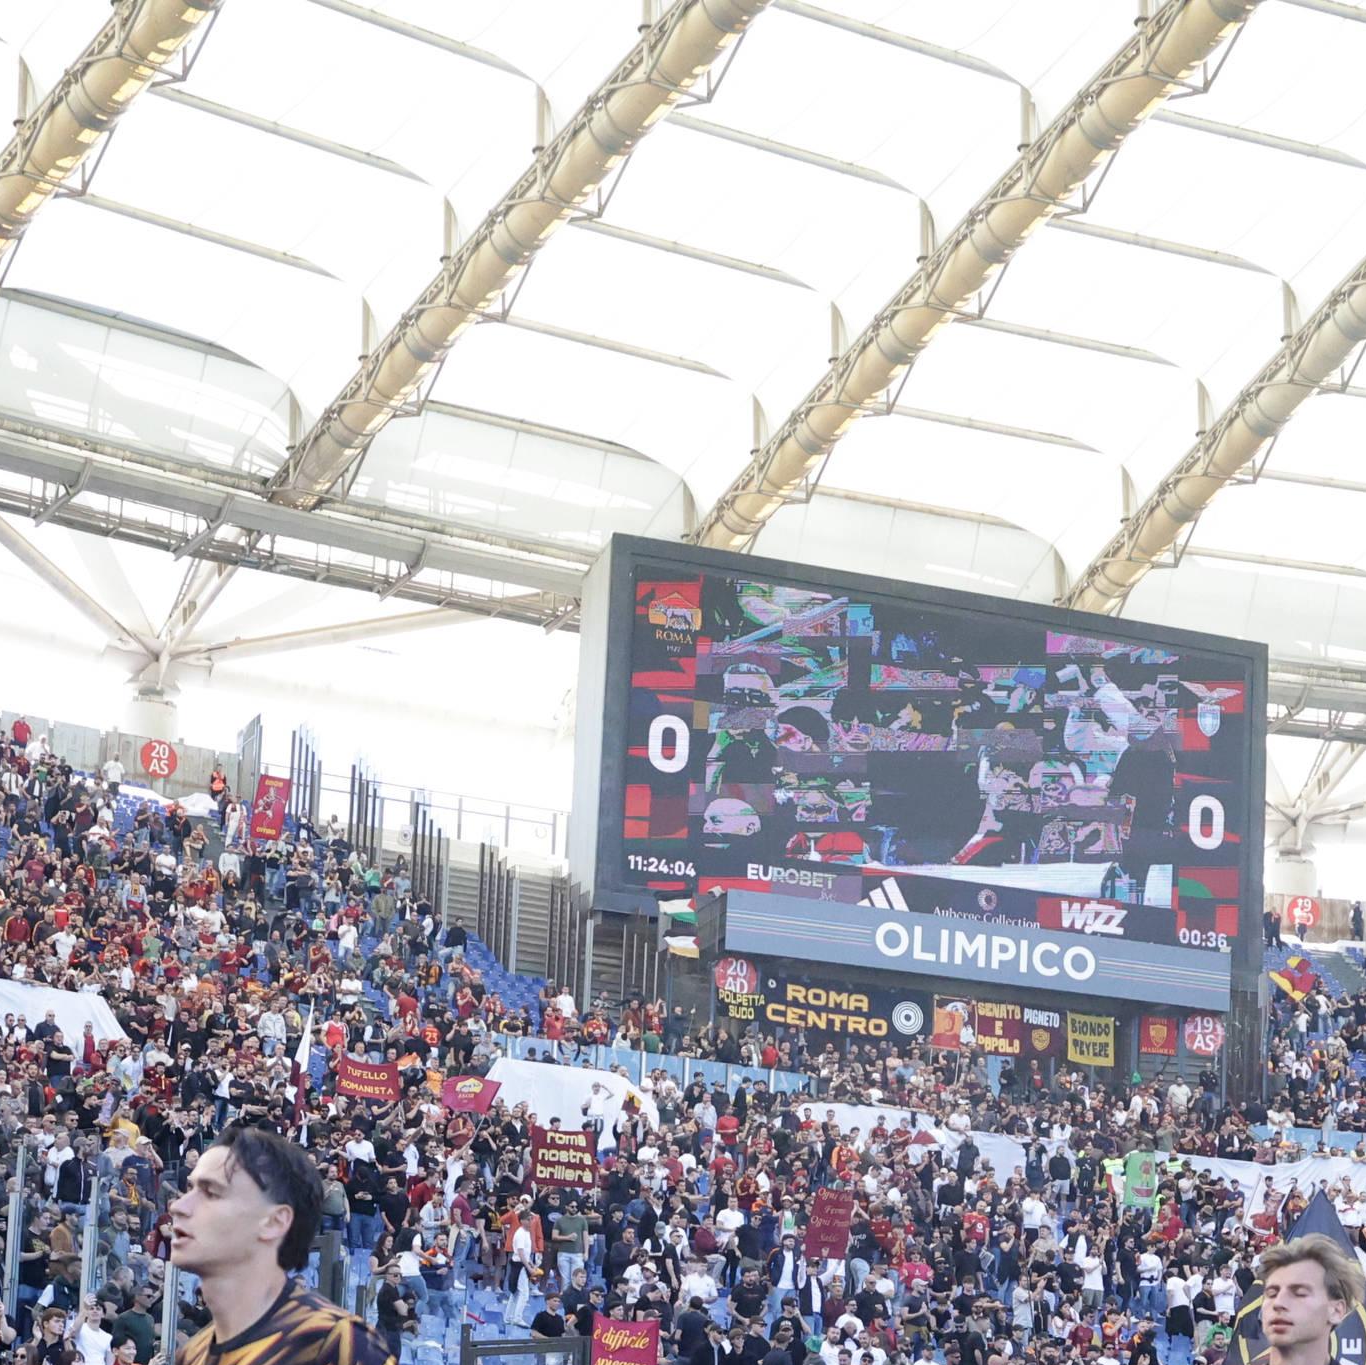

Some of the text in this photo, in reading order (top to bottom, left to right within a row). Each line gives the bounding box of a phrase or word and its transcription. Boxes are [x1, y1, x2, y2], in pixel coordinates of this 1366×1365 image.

[655, 629, 694, 645] ROMA
[150, 742, 169, 759] 20
[647, 714, 690, 773] 0
[149, 759, 169, 774] AS
[1189, 794, 1225, 850] 0
[628, 855, 696, 878] 11:24:04
[747, 863, 837, 888] EUROBET
[1179, 927, 1227, 949] 00:36
[875, 921, 1097, 981] OLIMPICO
[726, 957, 747, 976] 20
[718, 988, 765, 1006] POLPETTA
[787, 984, 869, 1012] ROMA
[766, 1002, 888, 1036] CENTRO
[977, 1002, 1021, 1020] SENATO
[1023, 1007, 1060, 1028] PIGNETO
[995, 1021, 1004, 1036] E
[1196, 1016, 1213, 1033] 19
[1192, 1033, 1215, 1051] AS
[346, 1065, 388, 1081] TUFELLO
[340, 1079, 394, 1095] ROMANISTA
[546, 1131, 586, 1147] roma
[538, 1148, 592, 1165] nostra
[602, 1326, 650, 1352] difficile
